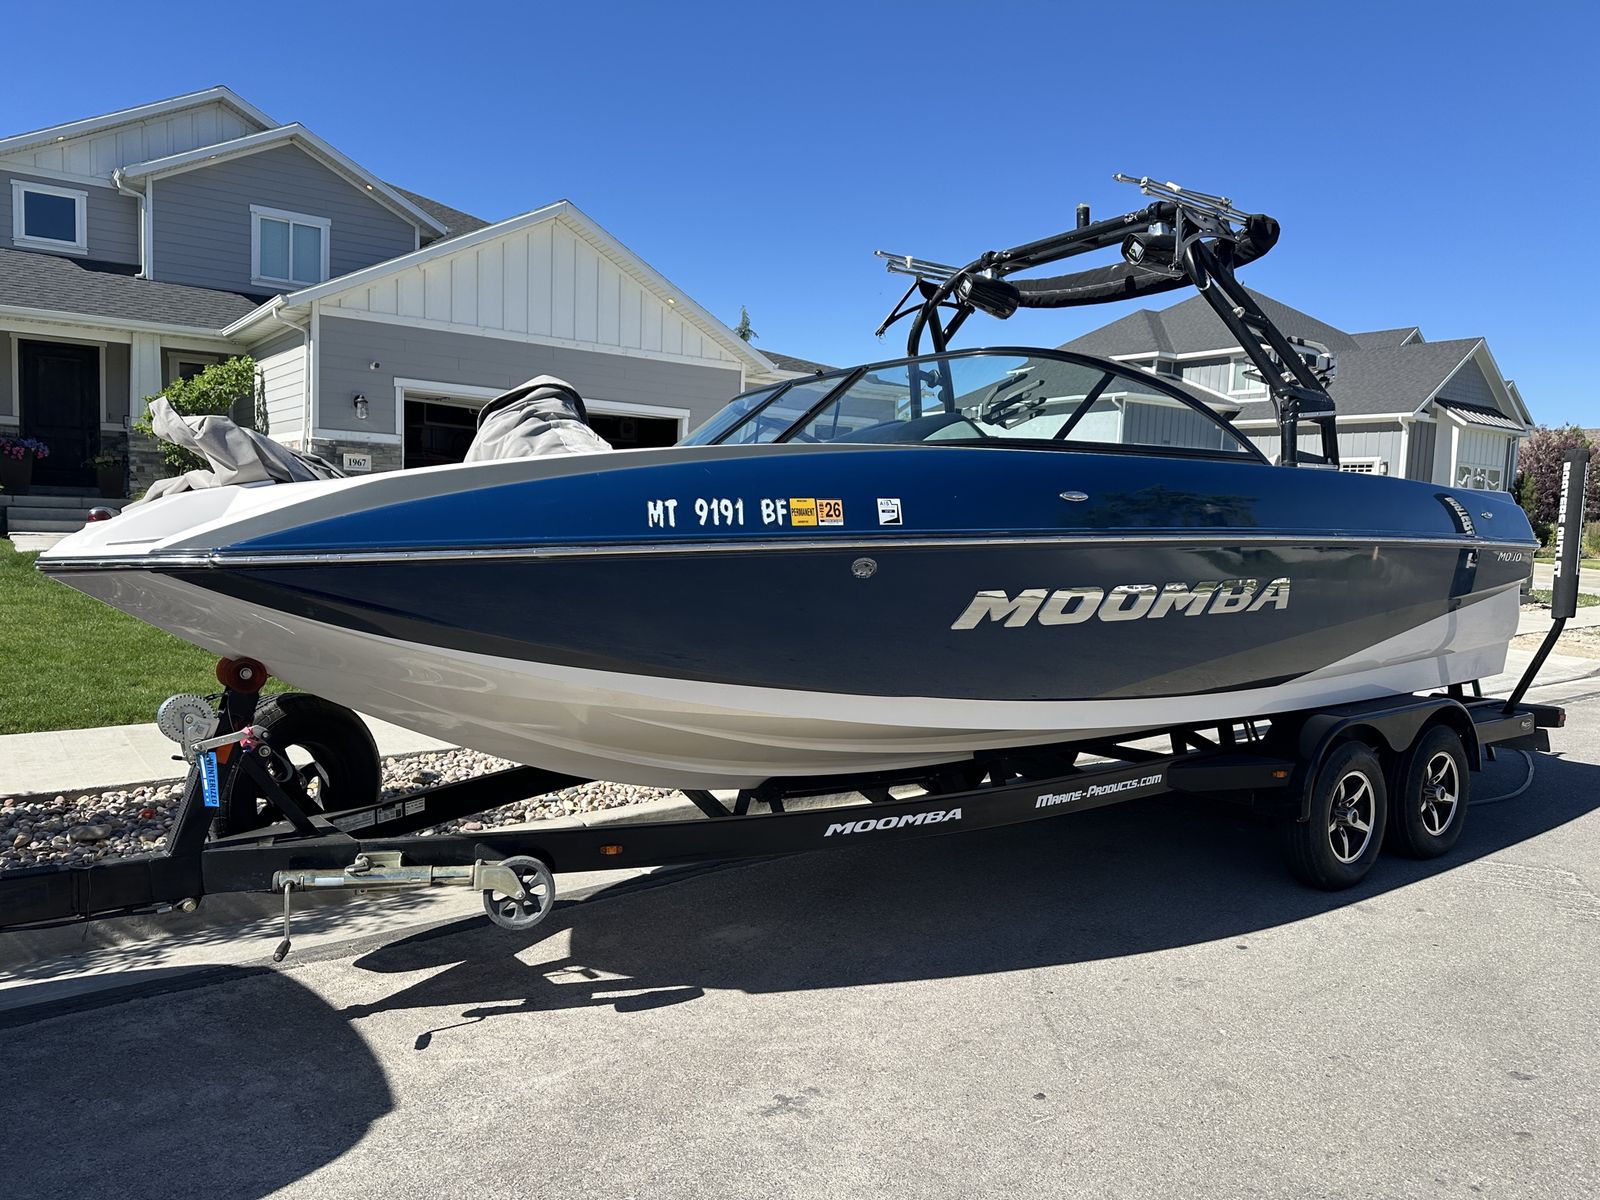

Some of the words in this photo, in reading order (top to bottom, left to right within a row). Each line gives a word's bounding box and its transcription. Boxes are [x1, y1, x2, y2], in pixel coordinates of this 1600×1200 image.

[348, 458, 367, 466] 1967
[1558, 461, 1572, 523] BOATERS
[647, 498, 678, 528] MT
[694, 497, 744, 526] 9191
[760, 498, 787, 526] BF
[791, 507, 815, 517] PERMANENT
[824, 501, 841, 518] 26
[1497, 552, 1522, 562] MOJO
[1553, 526, 1565, 578] OUTLET
[951, 577, 1291, 630] MOOMBA
[206, 758, 218, 805] WINTERIZED
[824, 808, 962, 837] MOOMBA
